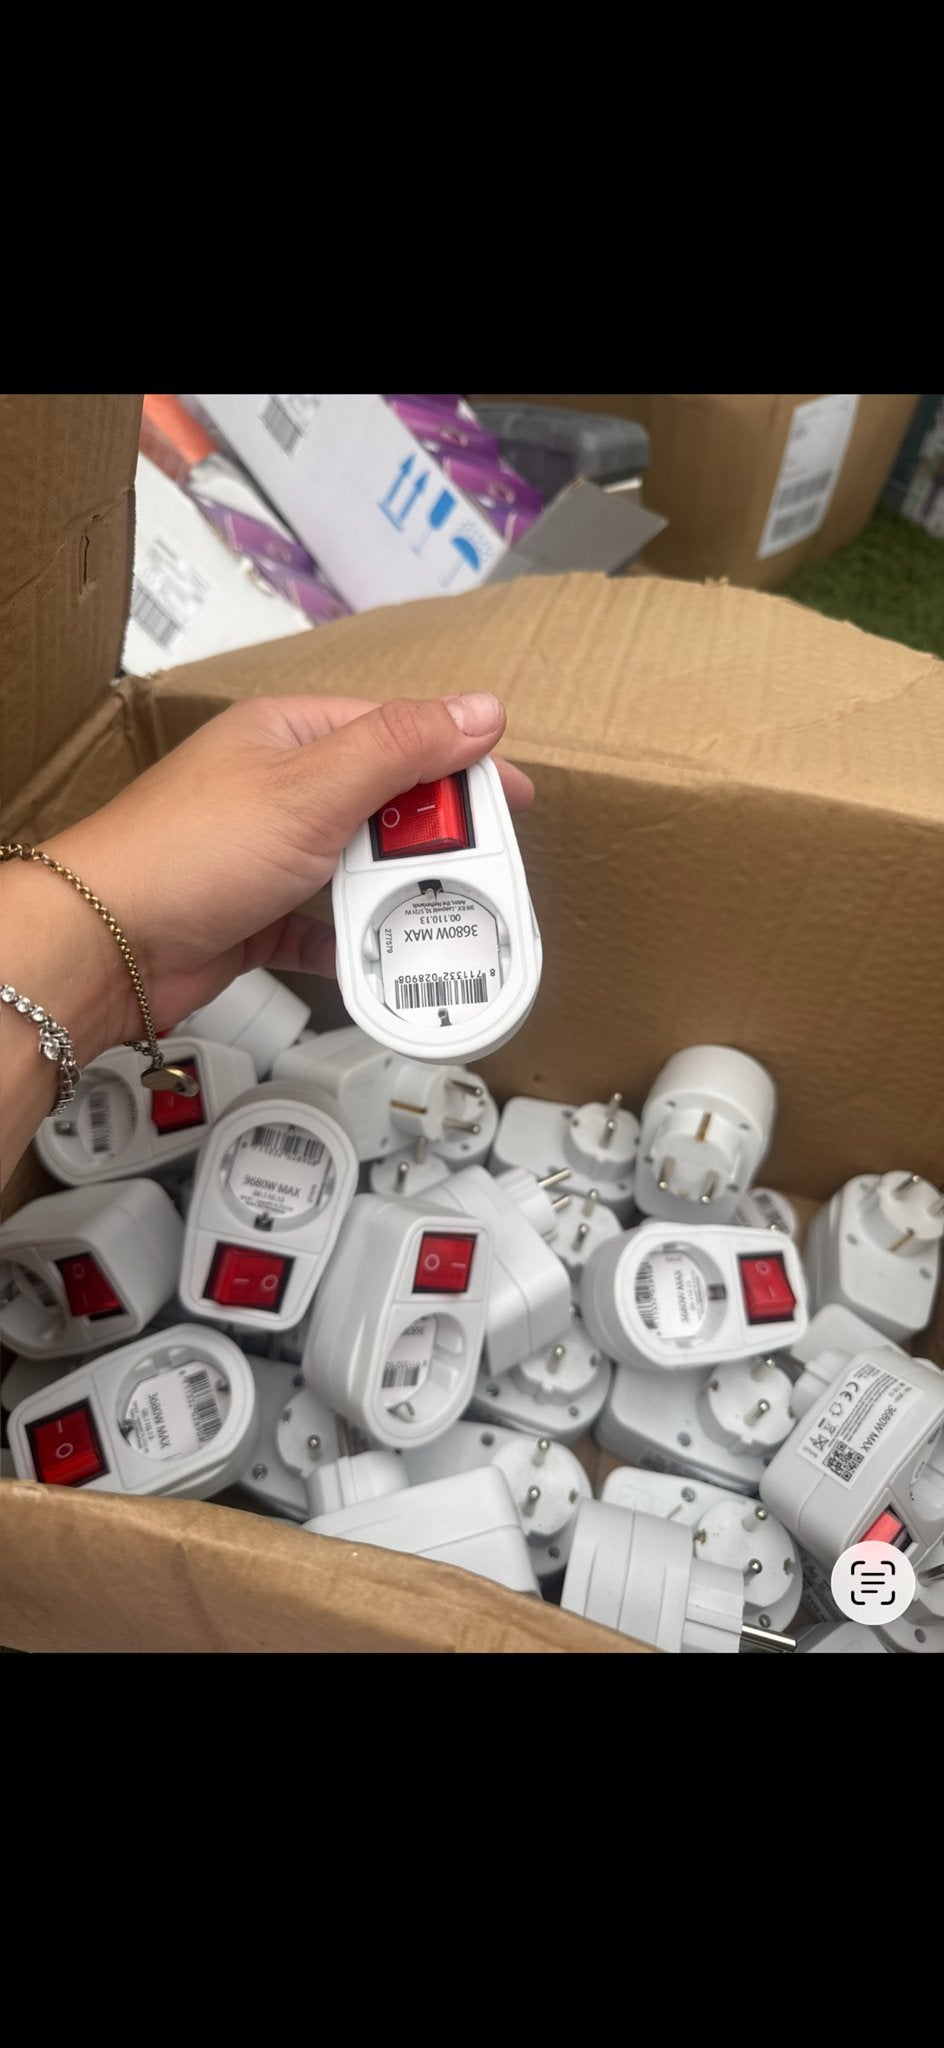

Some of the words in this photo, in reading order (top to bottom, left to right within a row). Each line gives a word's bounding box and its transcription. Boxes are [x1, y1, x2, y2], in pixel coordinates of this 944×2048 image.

[420, 914, 461, 924] 00.110.13
[404, 928, 433, 942] MAX
[436, 925, 478, 940] 3680W
[385, 928, 393, 954] 277579
[398, 973, 438, 984] 028908
[443, 970, 481, 980] 711332
[490, 968, 496, 977] 8
[278, 1183, 302, 1197] MAX
[148, 1391, 165, 1424] 3680W
[874, 1404, 897, 1434] 3680W
[156, 1425, 172, 1449] MAX
[860, 1431, 879, 1452] MAX
